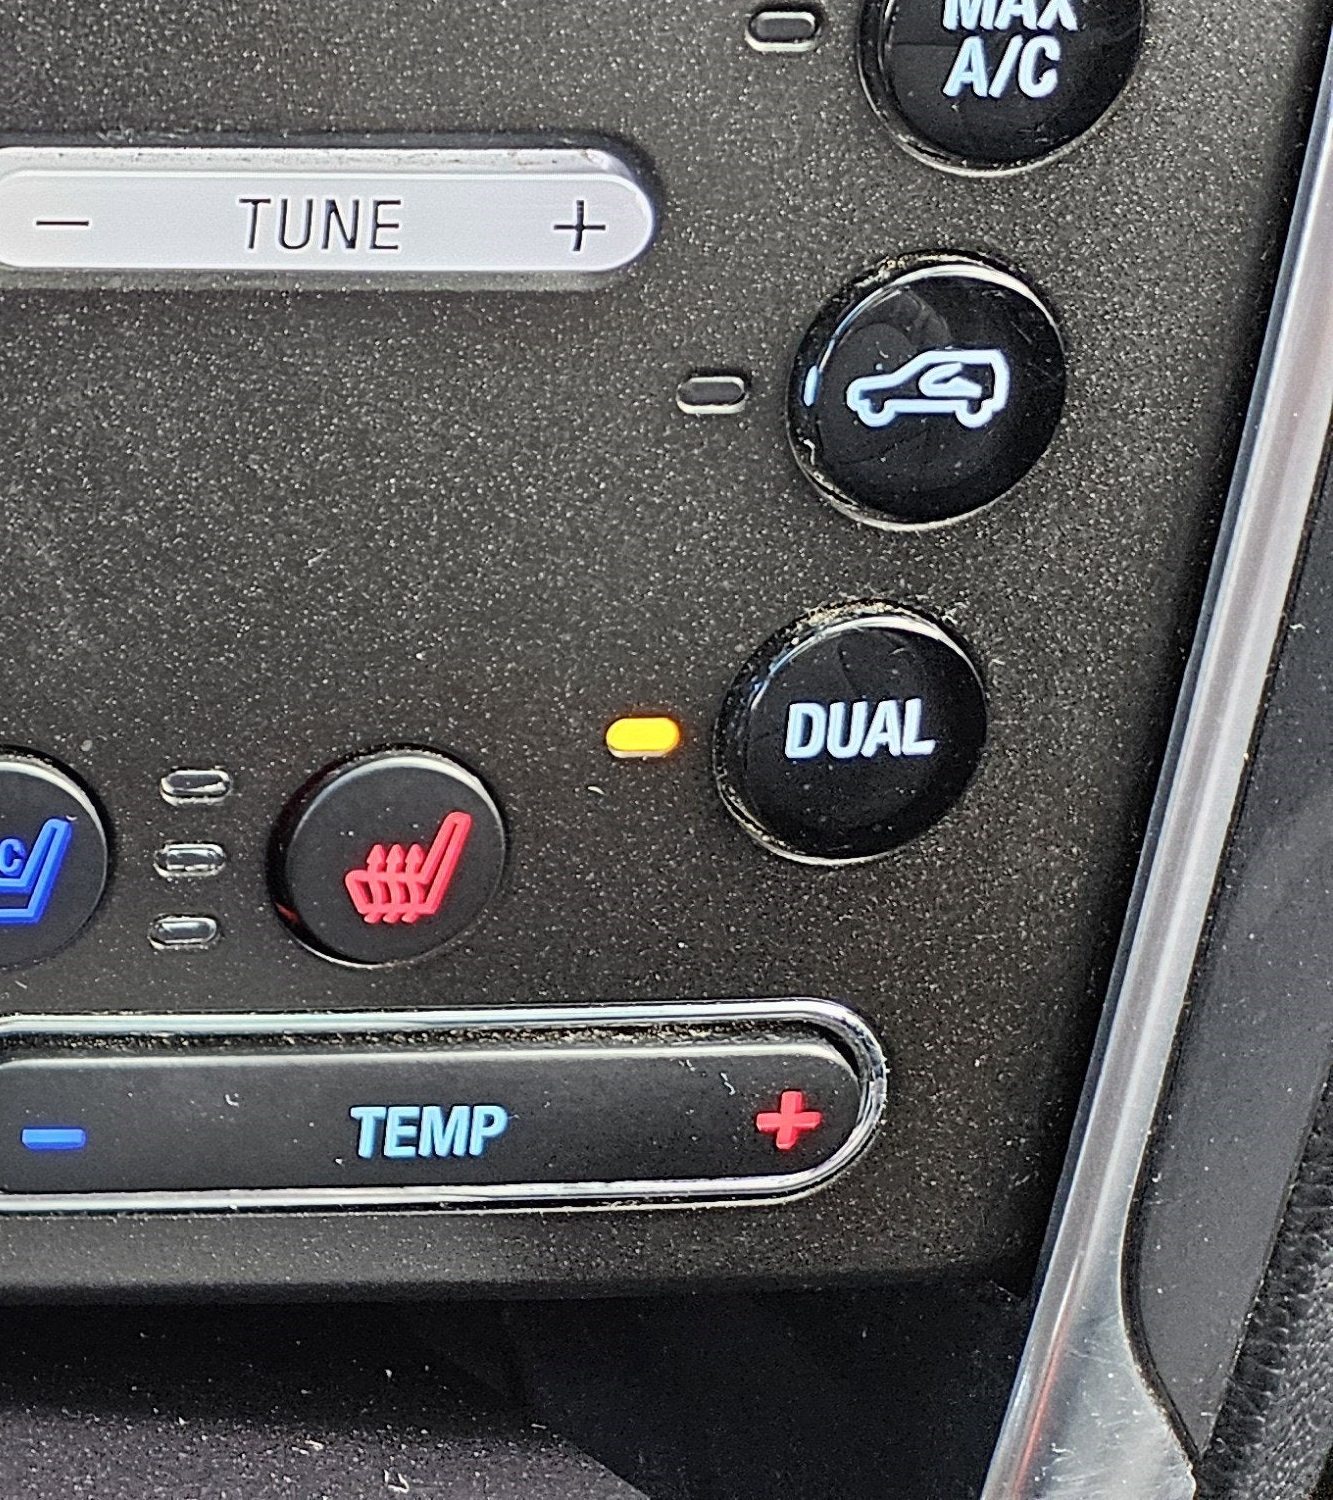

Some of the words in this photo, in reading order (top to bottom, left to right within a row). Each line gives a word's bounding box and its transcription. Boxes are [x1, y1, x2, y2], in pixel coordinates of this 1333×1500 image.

[942, 35, 1062, 99] A/C
[237, 197, 403, 251] TUNE
[784, 698, 936, 759] DUAL
[351, 1104, 508, 1159] TEMP
